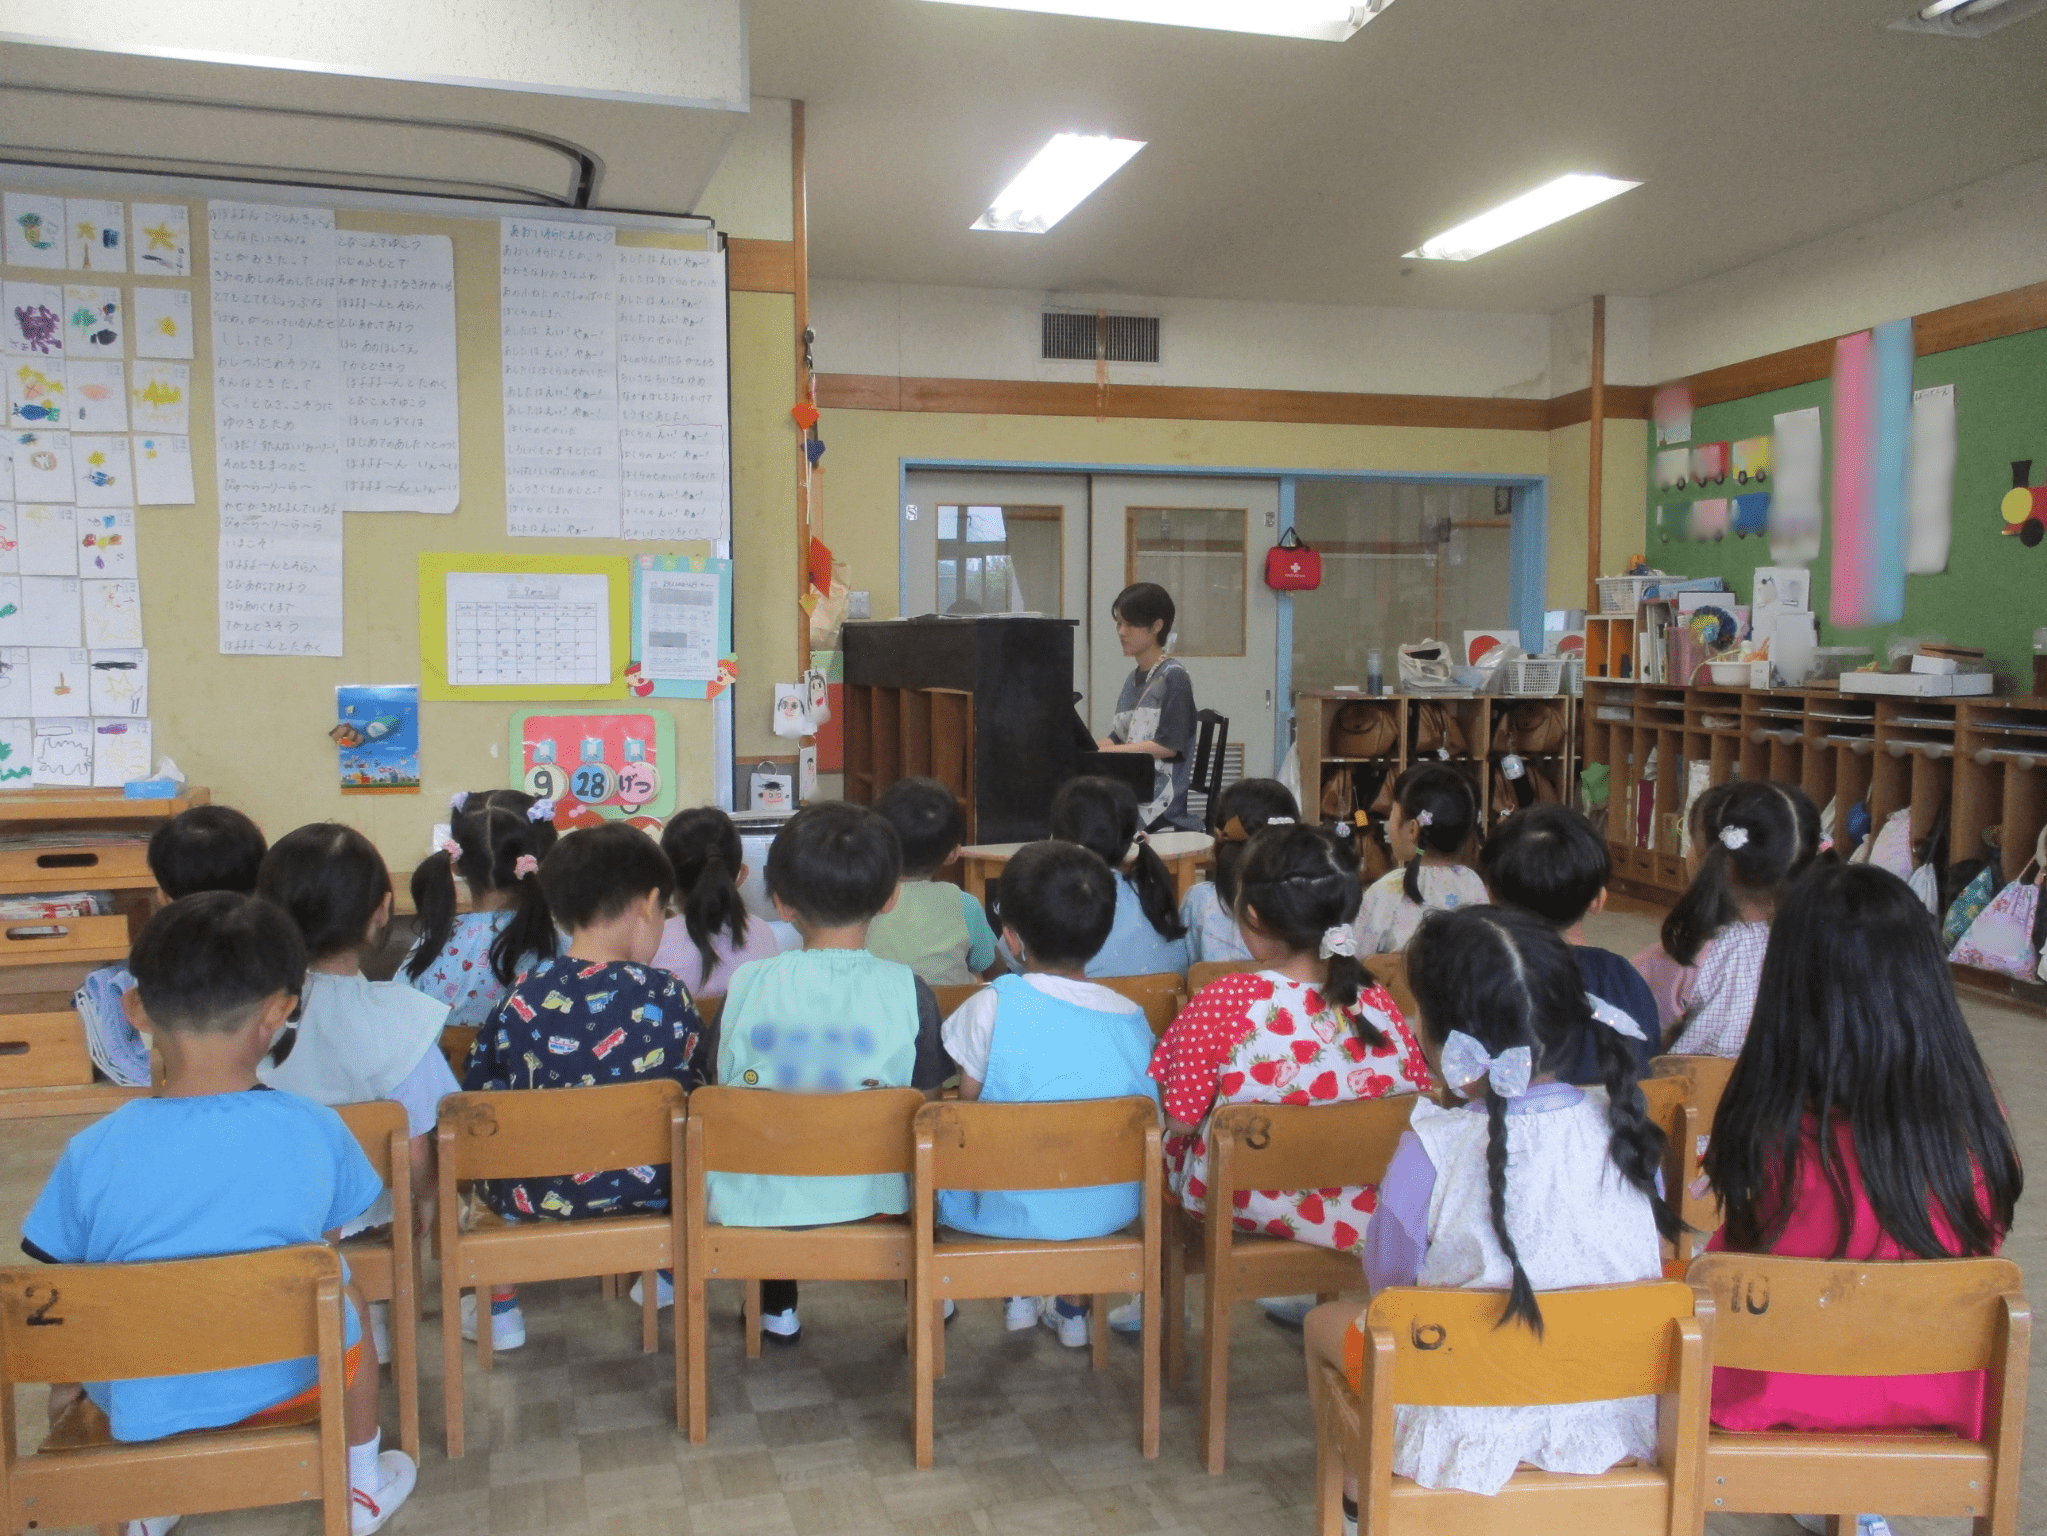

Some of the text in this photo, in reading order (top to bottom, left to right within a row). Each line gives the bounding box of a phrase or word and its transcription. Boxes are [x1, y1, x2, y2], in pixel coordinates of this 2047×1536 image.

[338, 236, 421, 250] とびこえてゆこう
[340, 318, 414, 334] とびあがってみよう
[342, 360, 406, 373] てがとどきそう
[348, 396, 427, 408] とびこえてゆこう
[223, 415, 295, 431] ゆうきをため
[348, 415, 424, 427] ほしのしずくは
[223, 458, 307, 472] そのときをまつのさ
[225, 579, 307, 594] とびあがってみよう
[225, 599, 296, 615] ほらあのくもまで
[226, 620, 300, 635] てがとどきそう
[534, 770, 554, 800] 9
[575, 771, 605, 799] 28
[618, 773, 652, 794] げつ
[25, 1281, 66, 1327] 2
